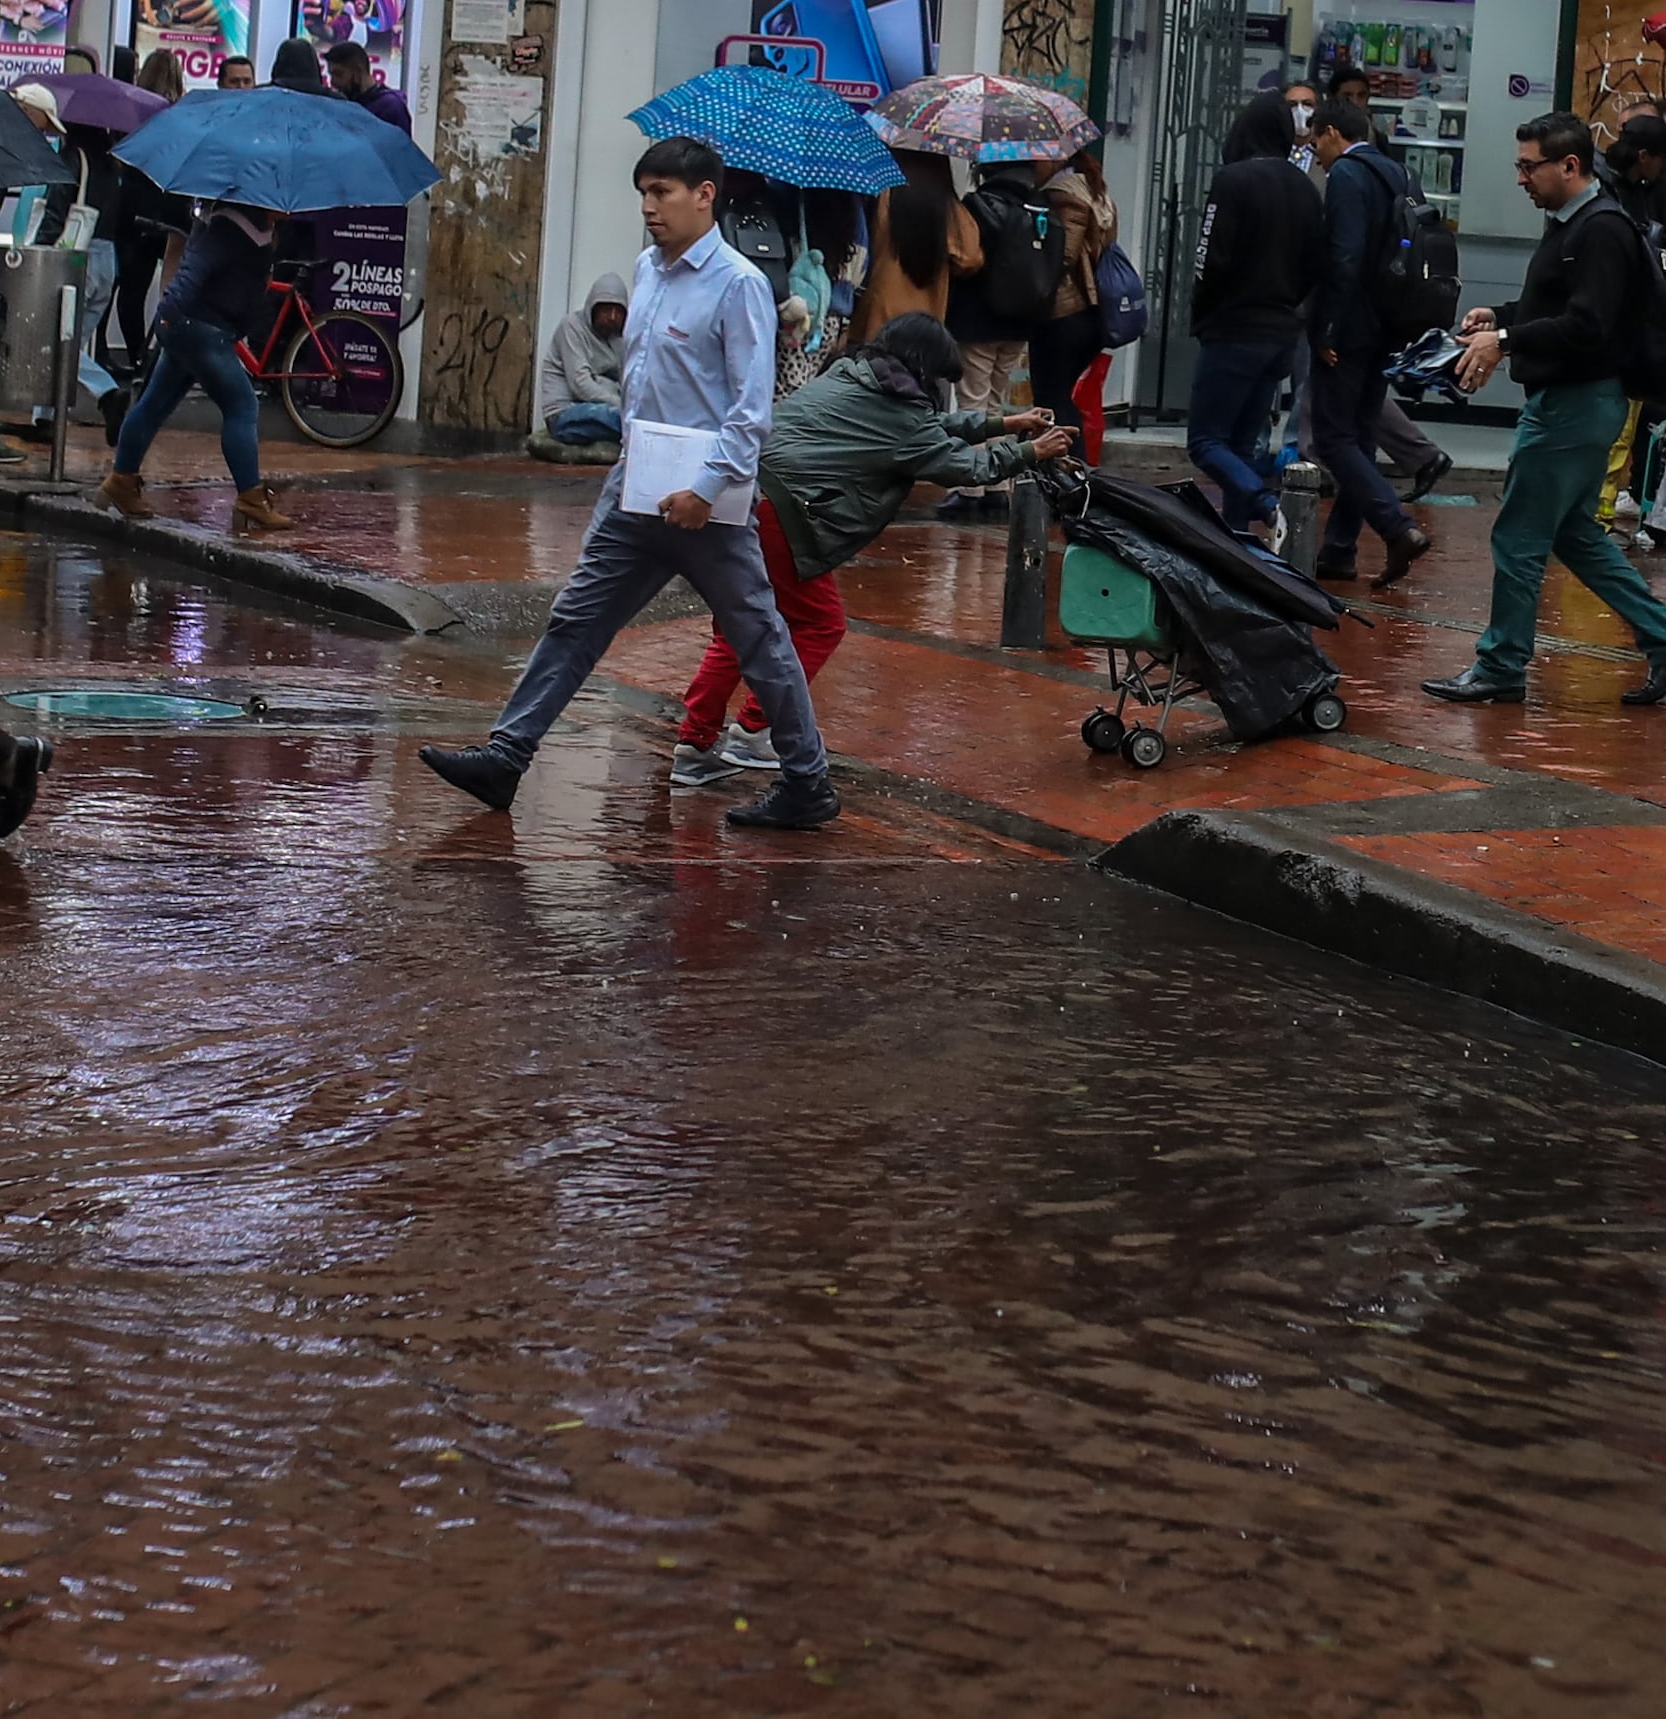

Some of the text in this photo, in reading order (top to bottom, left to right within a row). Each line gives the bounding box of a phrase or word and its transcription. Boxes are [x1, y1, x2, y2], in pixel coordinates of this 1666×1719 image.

[330, 258, 403, 293] 2 LÍNEAS
[351, 280, 403, 297] POSPAGO
